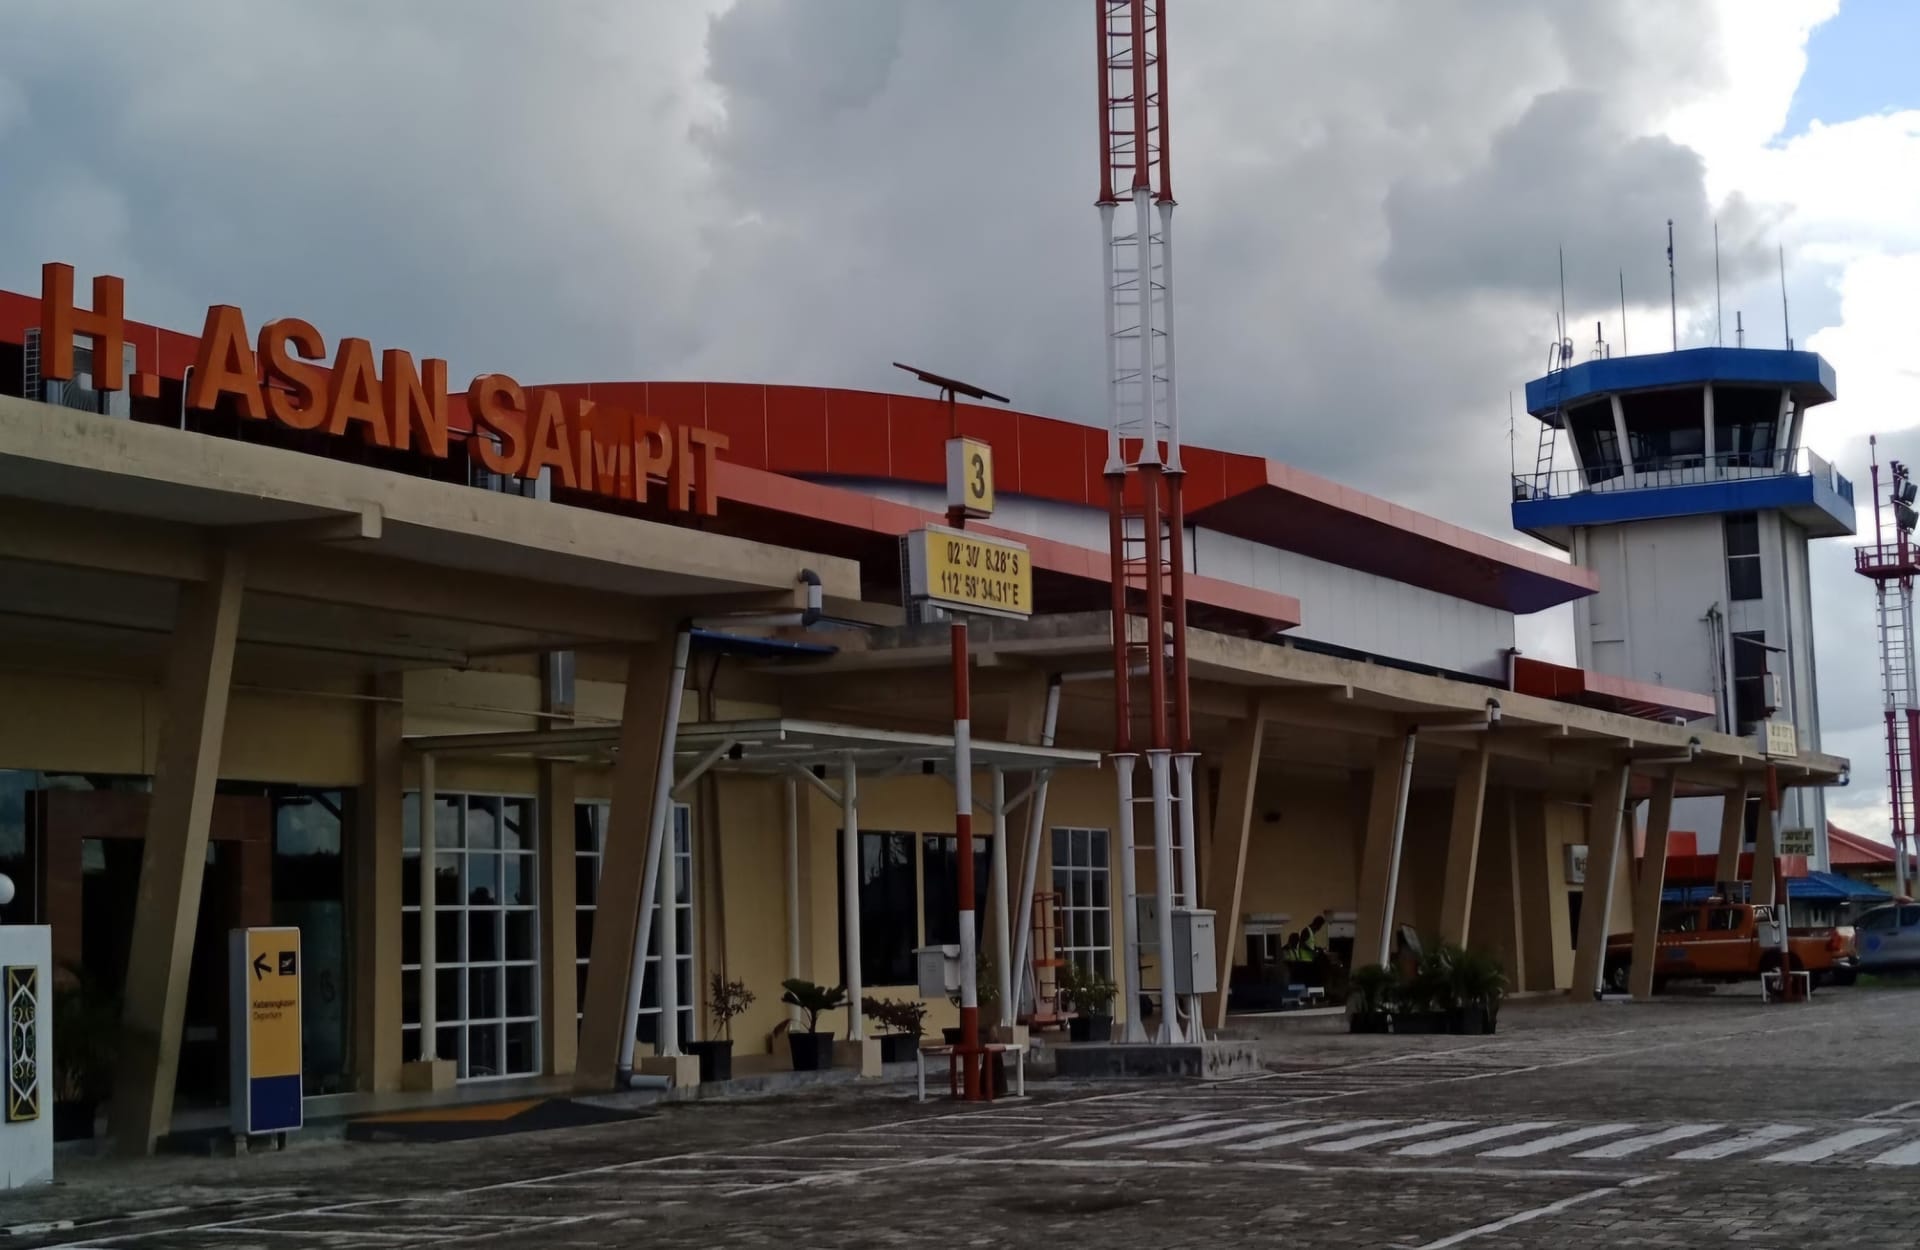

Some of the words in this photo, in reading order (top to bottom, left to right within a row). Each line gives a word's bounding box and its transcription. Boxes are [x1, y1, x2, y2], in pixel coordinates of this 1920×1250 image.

[42, 262, 159, 398] H.
[187, 304, 448, 459] ASAN
[468, 373, 729, 516] SAMPIT
[971, 453, 985, 498] 3
